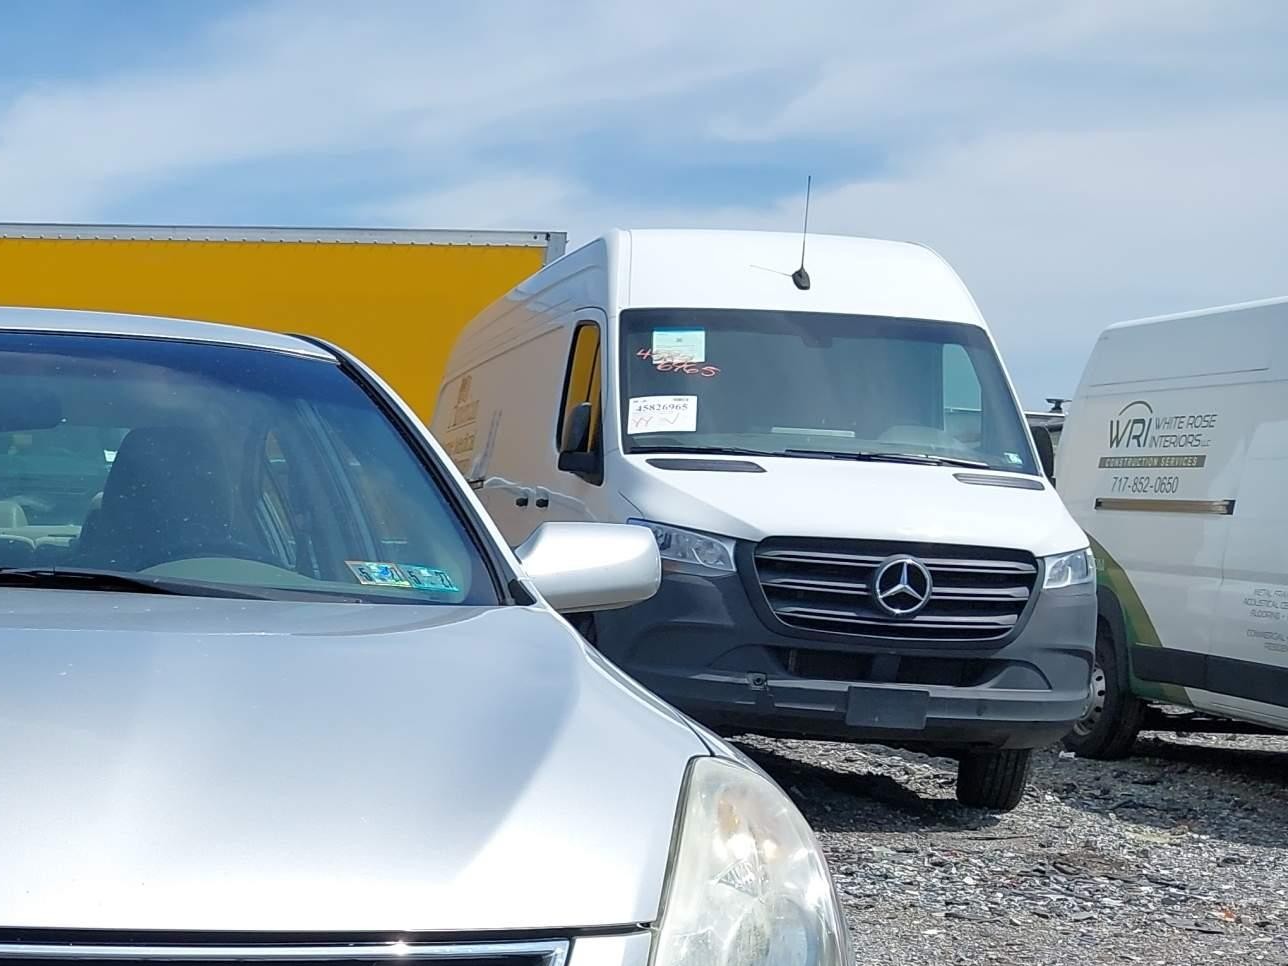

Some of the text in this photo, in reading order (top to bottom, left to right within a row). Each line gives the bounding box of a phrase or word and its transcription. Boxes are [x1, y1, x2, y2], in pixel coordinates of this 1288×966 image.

[636, 403, 689, 412] 45826965
[1154, 414, 1218, 430] WHITE ROSE
[1109, 418, 1153, 449] WRI
[1149, 433, 1202, 449] INTERIORS
[1105, 456, 1198, 467] CONSTRUCTION SERVICES
[1111, 476, 1179, 494] 717-852-0650
